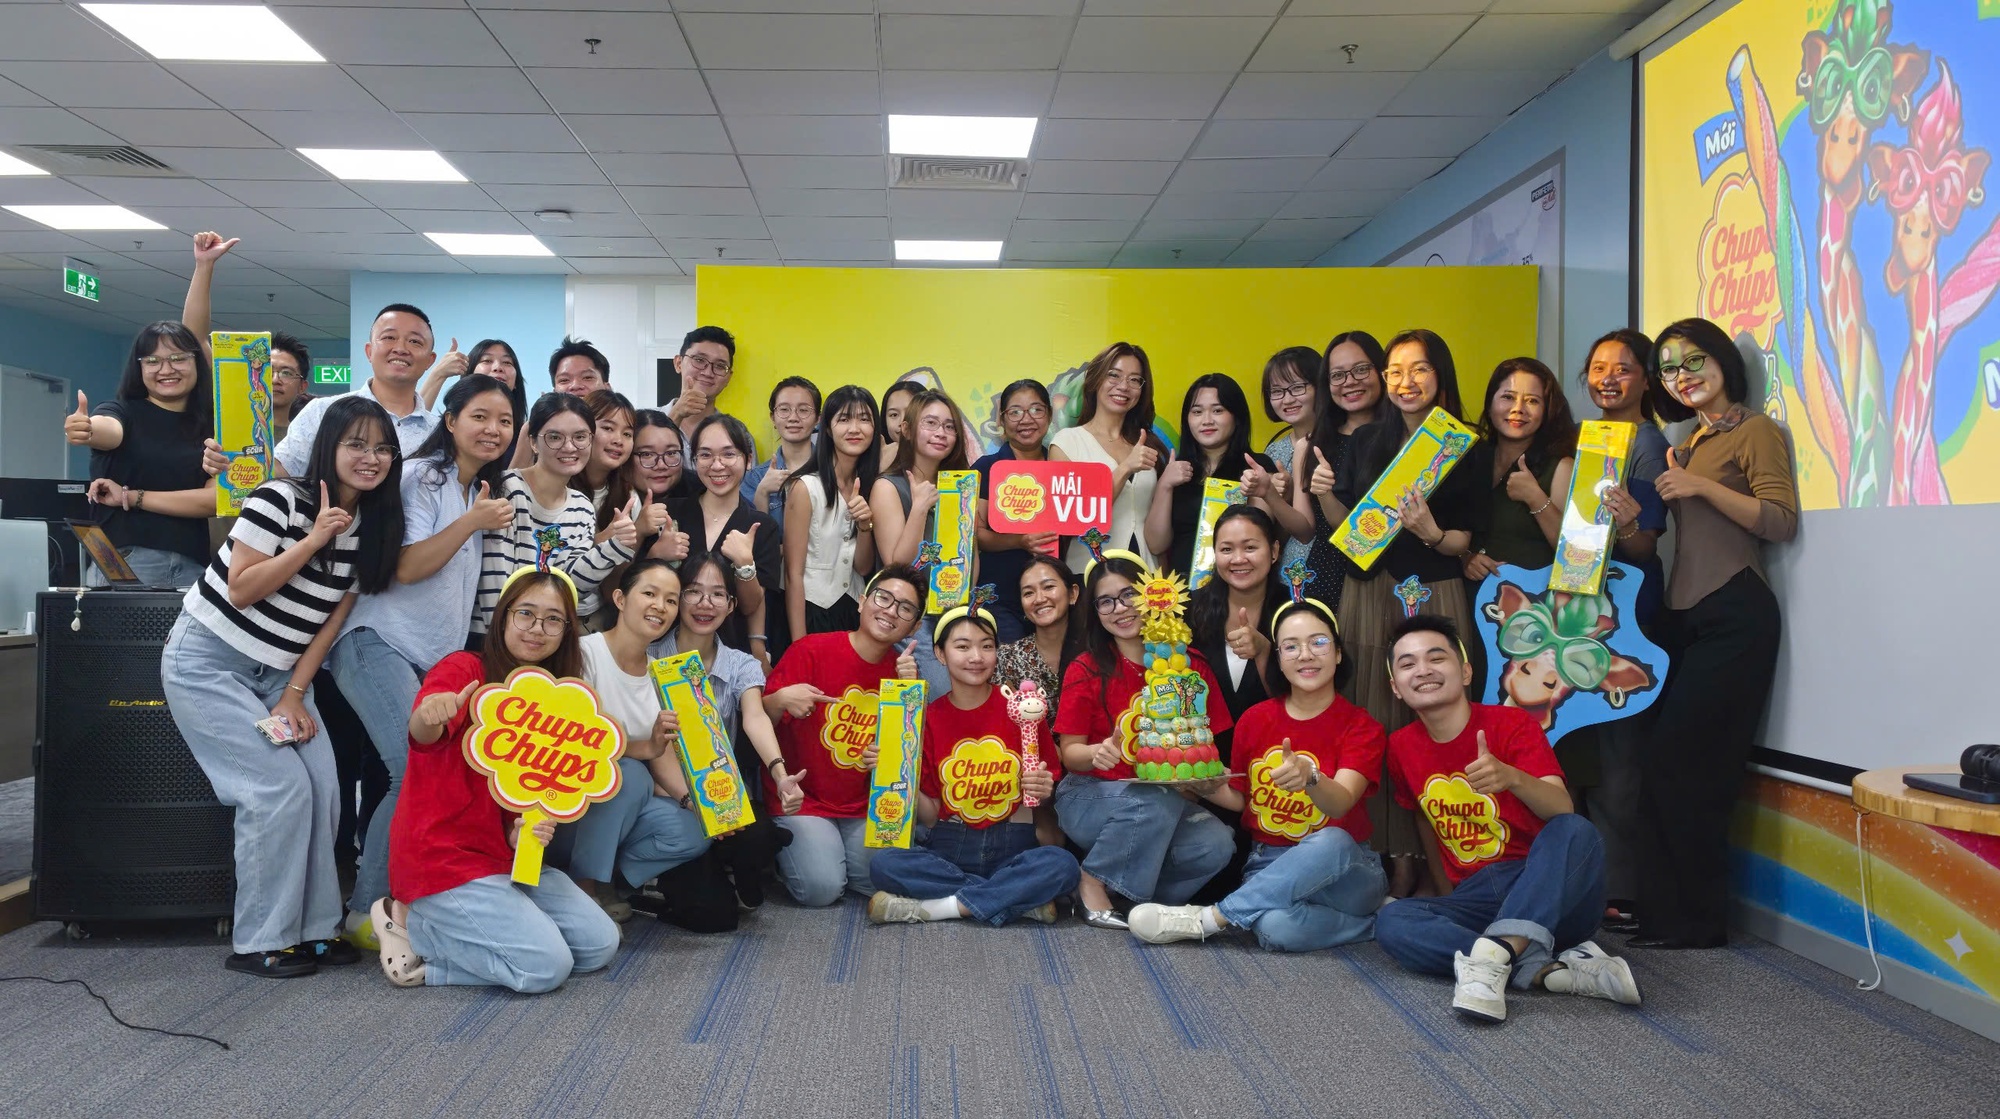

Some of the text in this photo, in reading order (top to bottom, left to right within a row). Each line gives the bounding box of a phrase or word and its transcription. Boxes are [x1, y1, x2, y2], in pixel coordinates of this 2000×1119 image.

[1705, 121, 1737, 160] Mới
[1708, 265, 1776, 340] Chups
[321, 367, 351, 382] EXI
[246, 447, 263, 455] SOUR
[230, 472, 259, 486] Chups
[232, 463, 260, 474] Chupa
[1003, 484, 1039, 500] Chupa
[1051, 472, 1082, 495] MÃI
[1001, 495, 1038, 515] Chups
[1052, 496, 1107, 524] VUI
[496, 697, 608, 750] Chupa
[838, 704, 877, 731] Chup
[830, 723, 876, 758] Chup
[483, 728, 600, 793] Chups
[952, 759, 1012, 782] Chupa
[709, 785, 732, 799] Chups
[952, 779, 1012, 810] Chups
[1252, 787, 1315, 824] Chups
[1427, 799, 1486, 821] Chupa
